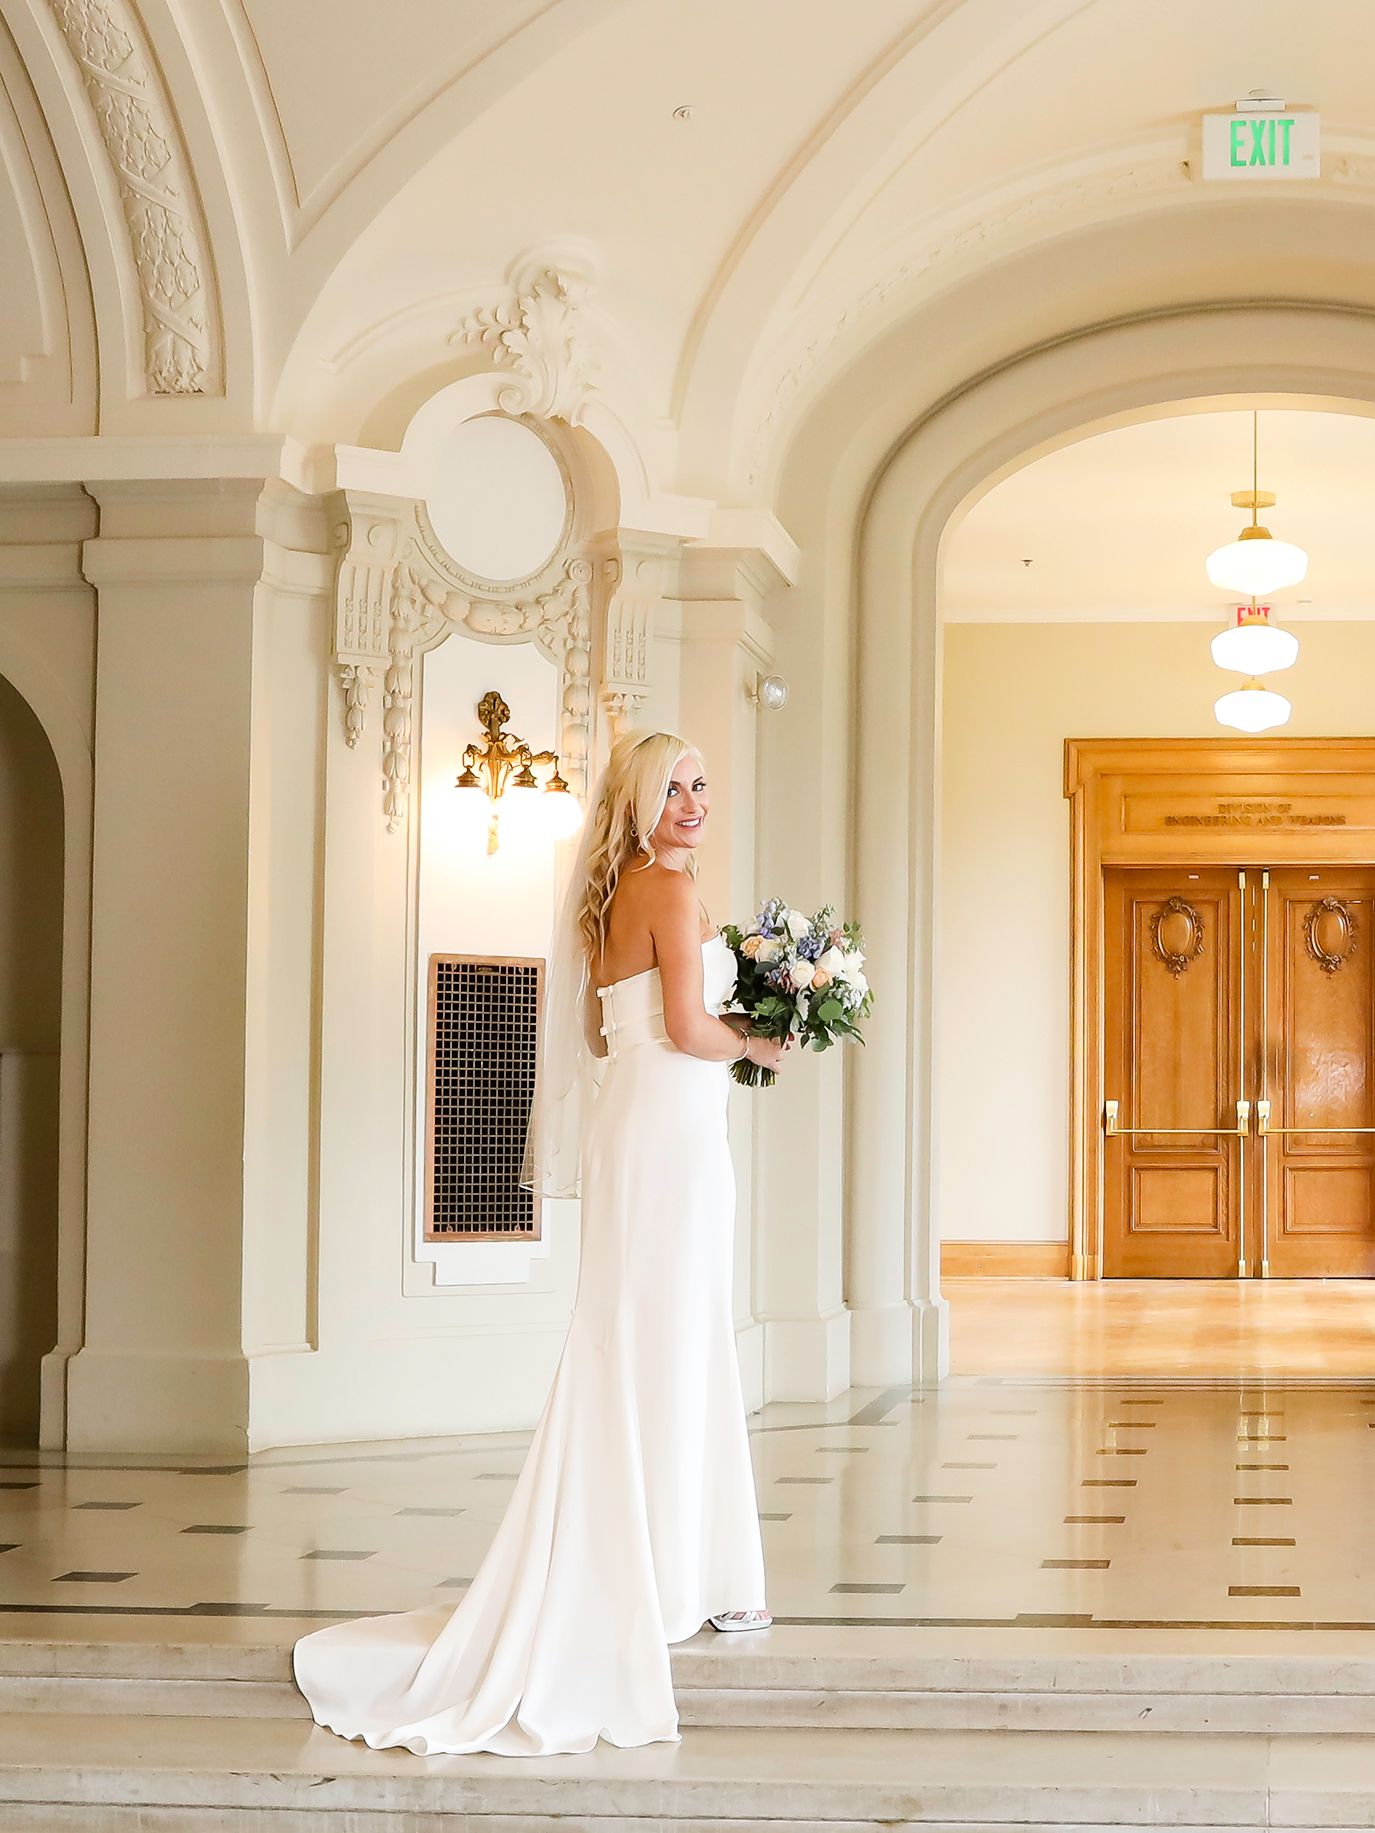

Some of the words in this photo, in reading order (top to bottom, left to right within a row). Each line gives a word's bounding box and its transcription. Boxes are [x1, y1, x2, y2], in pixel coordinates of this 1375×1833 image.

[1230, 119, 1295, 167] EXIT
[1217, 803, 1272, 814] DIVISION
[1278, 803, 1293, 814] OF
[1164, 815, 1251, 826] ENGINEERING
[1256, 815, 1282, 826] AND
[1288, 815, 1347, 826] WEAPONS
